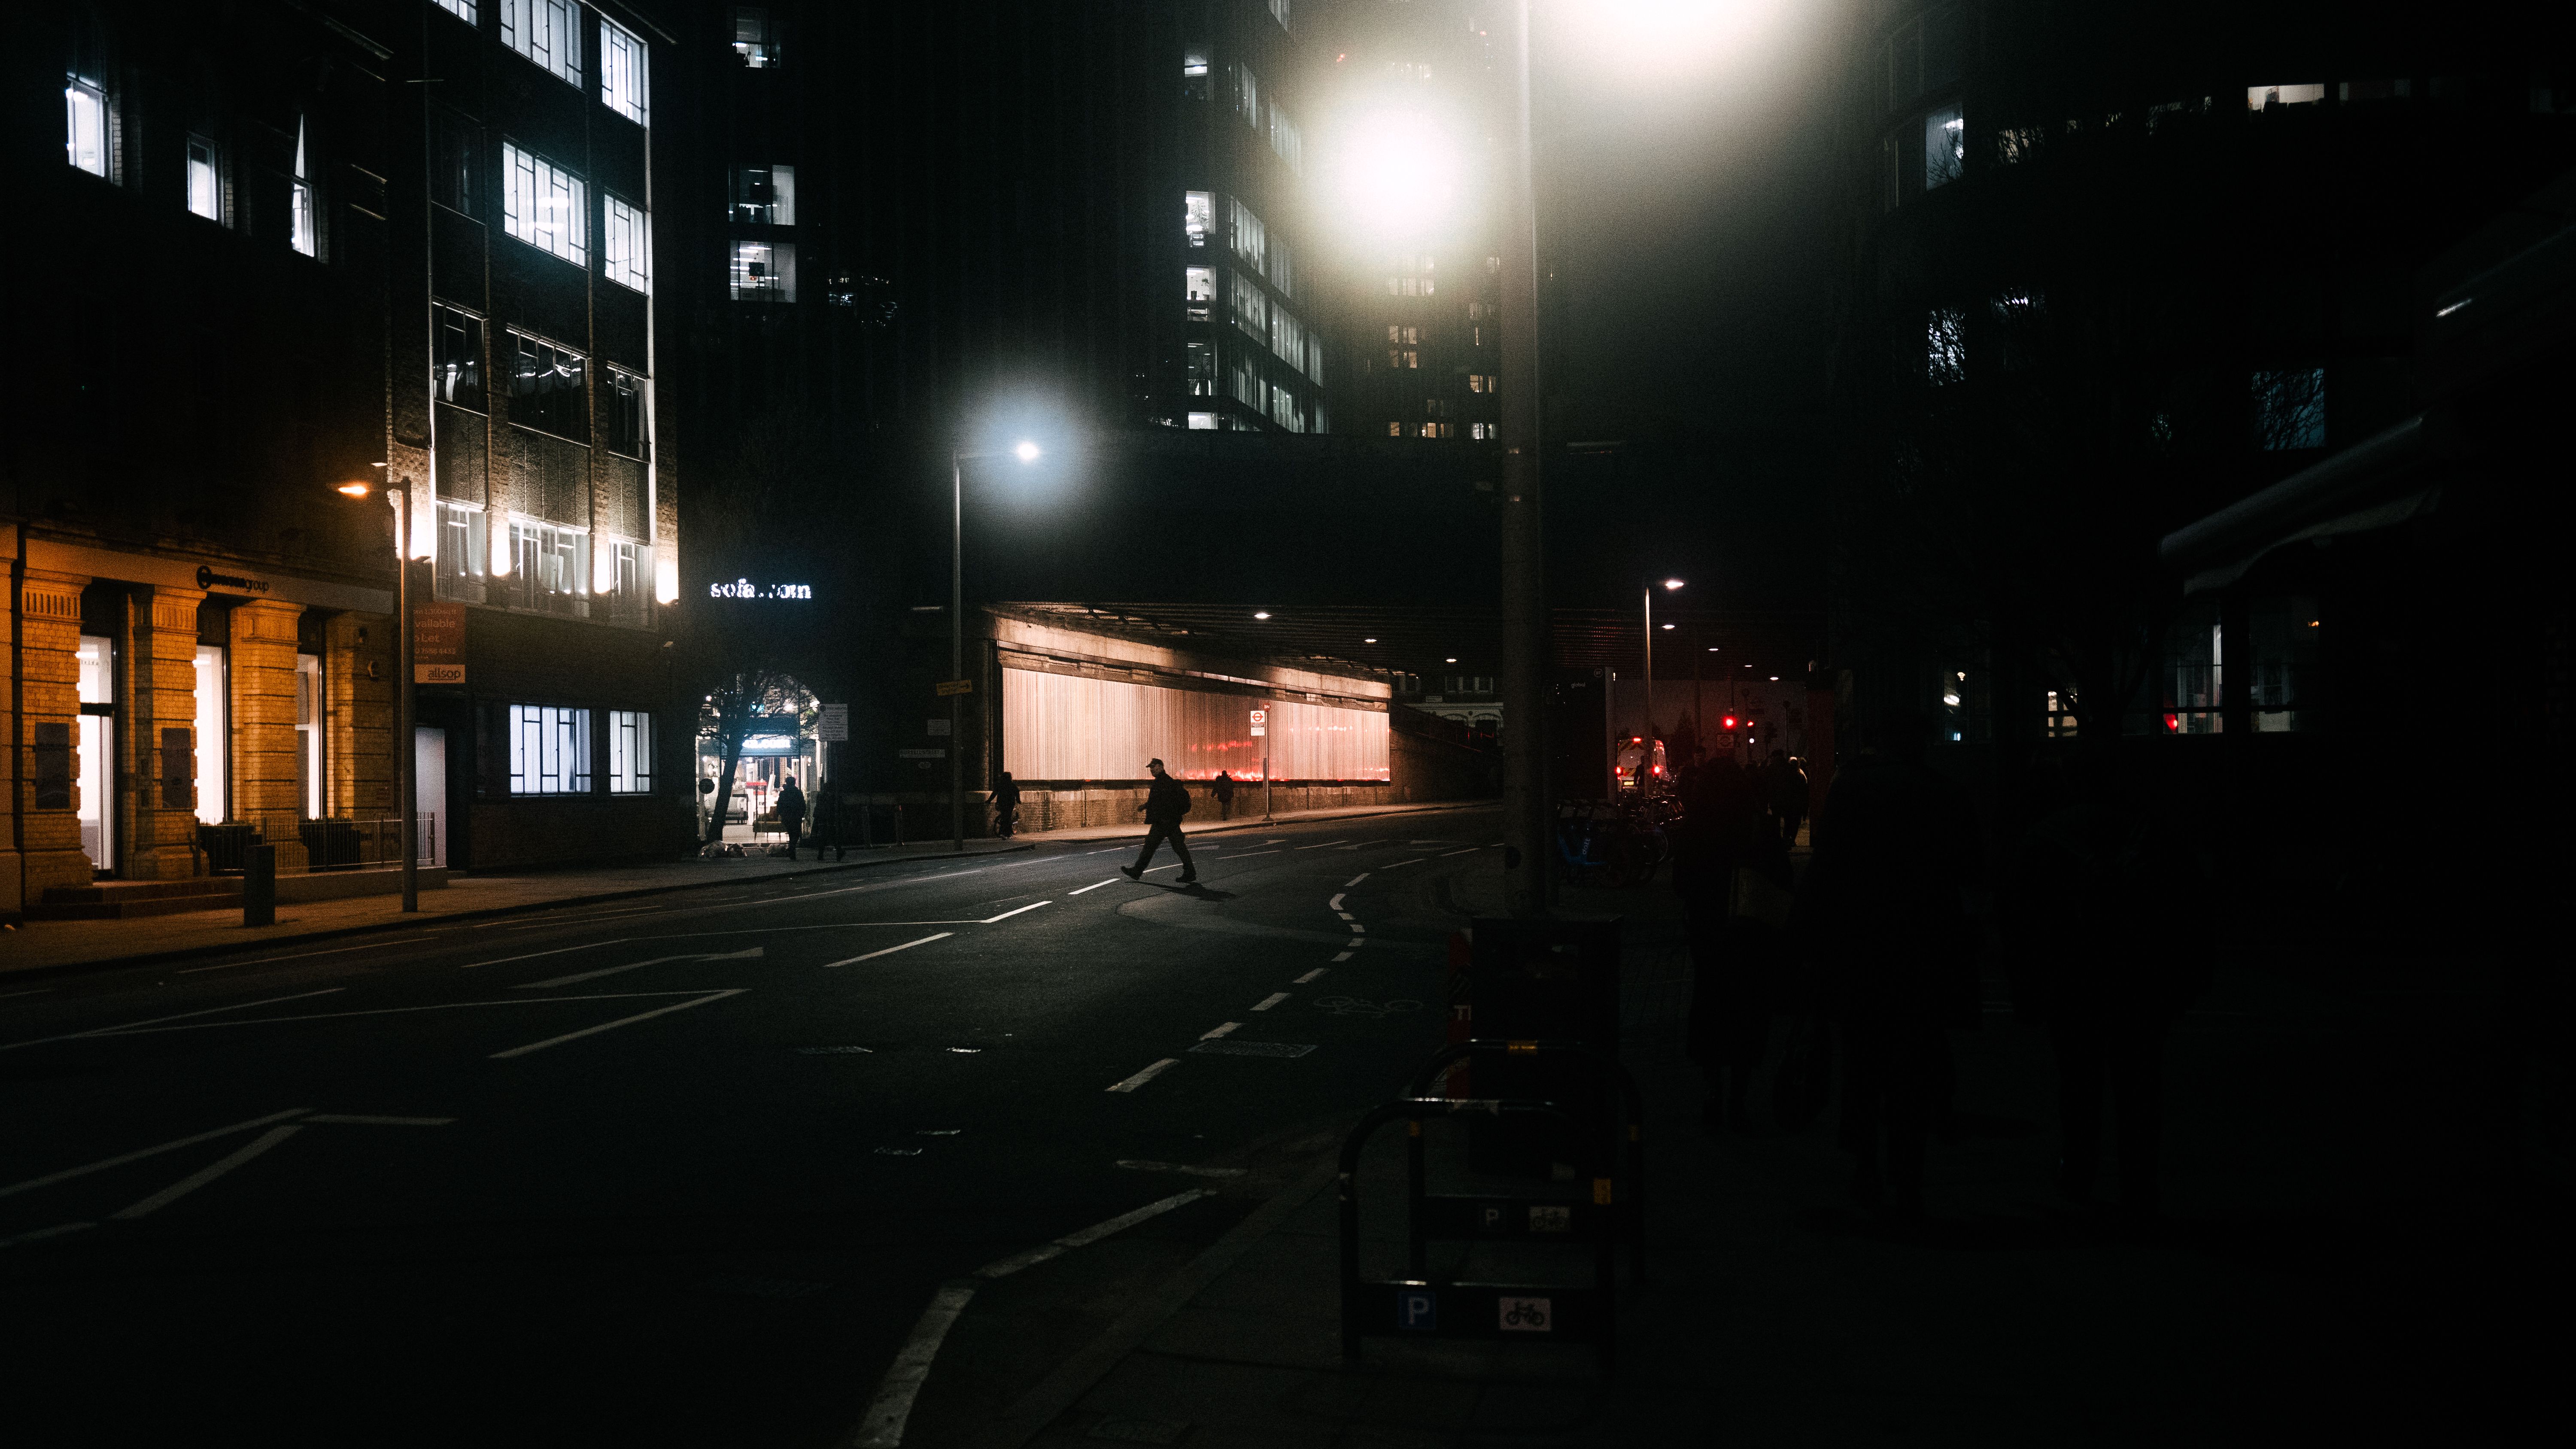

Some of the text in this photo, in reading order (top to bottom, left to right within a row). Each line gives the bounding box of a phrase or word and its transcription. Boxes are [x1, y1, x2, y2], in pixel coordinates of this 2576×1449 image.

[414, 618, 456, 628] vailable
[421, 633, 440, 642] Let
[428, 667, 461, 680] allsop
[1485, 1208, 1499, 1227] P
[1408, 1297, 1429, 1324] P
